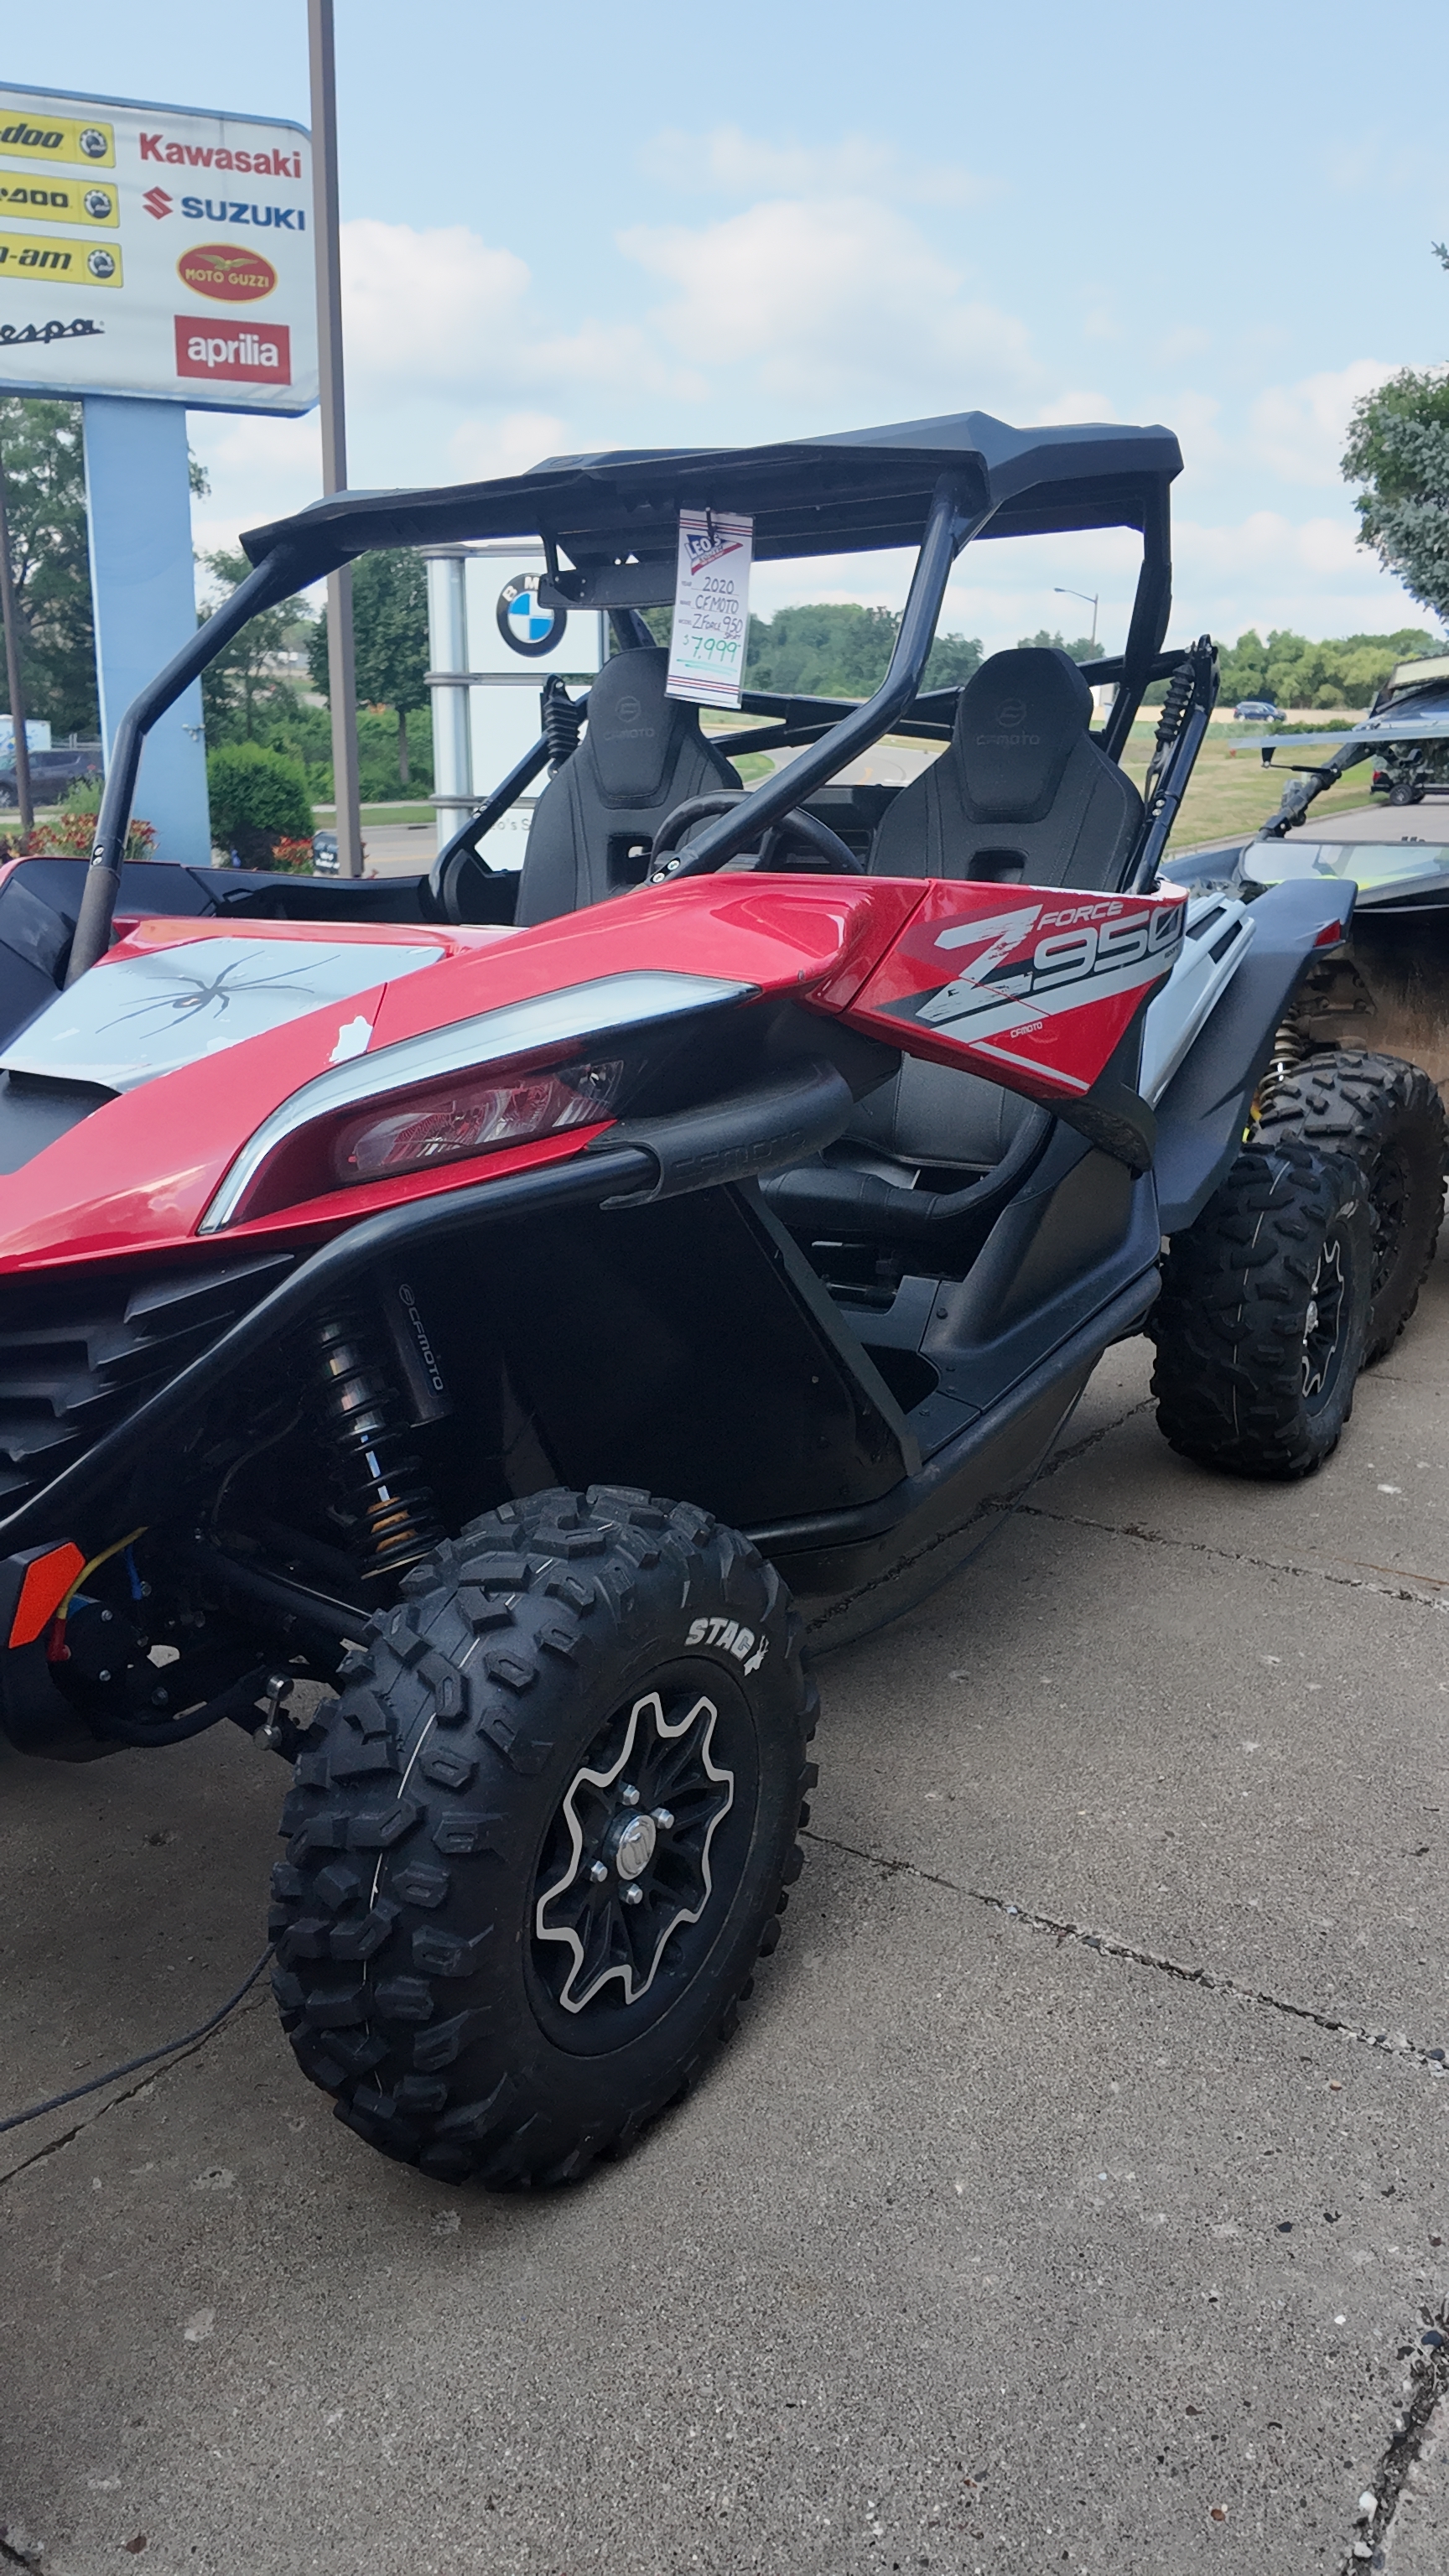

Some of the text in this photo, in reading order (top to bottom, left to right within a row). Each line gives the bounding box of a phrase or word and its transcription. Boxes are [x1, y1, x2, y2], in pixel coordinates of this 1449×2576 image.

[139, 132, 302, 179] Kawasaki
[181, 196, 306, 231] SUZUKI
[185, 268, 269, 288] MOTO GUZZI
[187, 333, 279, 367] aprilia
[501, 576, 540, 602] BM
[702, 576, 735, 595] 2020
[694, 594, 740, 615] CFMOTO
[722, 615, 744, 634] 950
[1036, 901, 1124, 931] FORCE
[1032, 904, 1184, 991] 950
[1010, 1021, 1043, 1038] CFMOTO
[408, 1306, 444, 1391] CFMOTO
[683, 1617, 756, 1662] STAG
